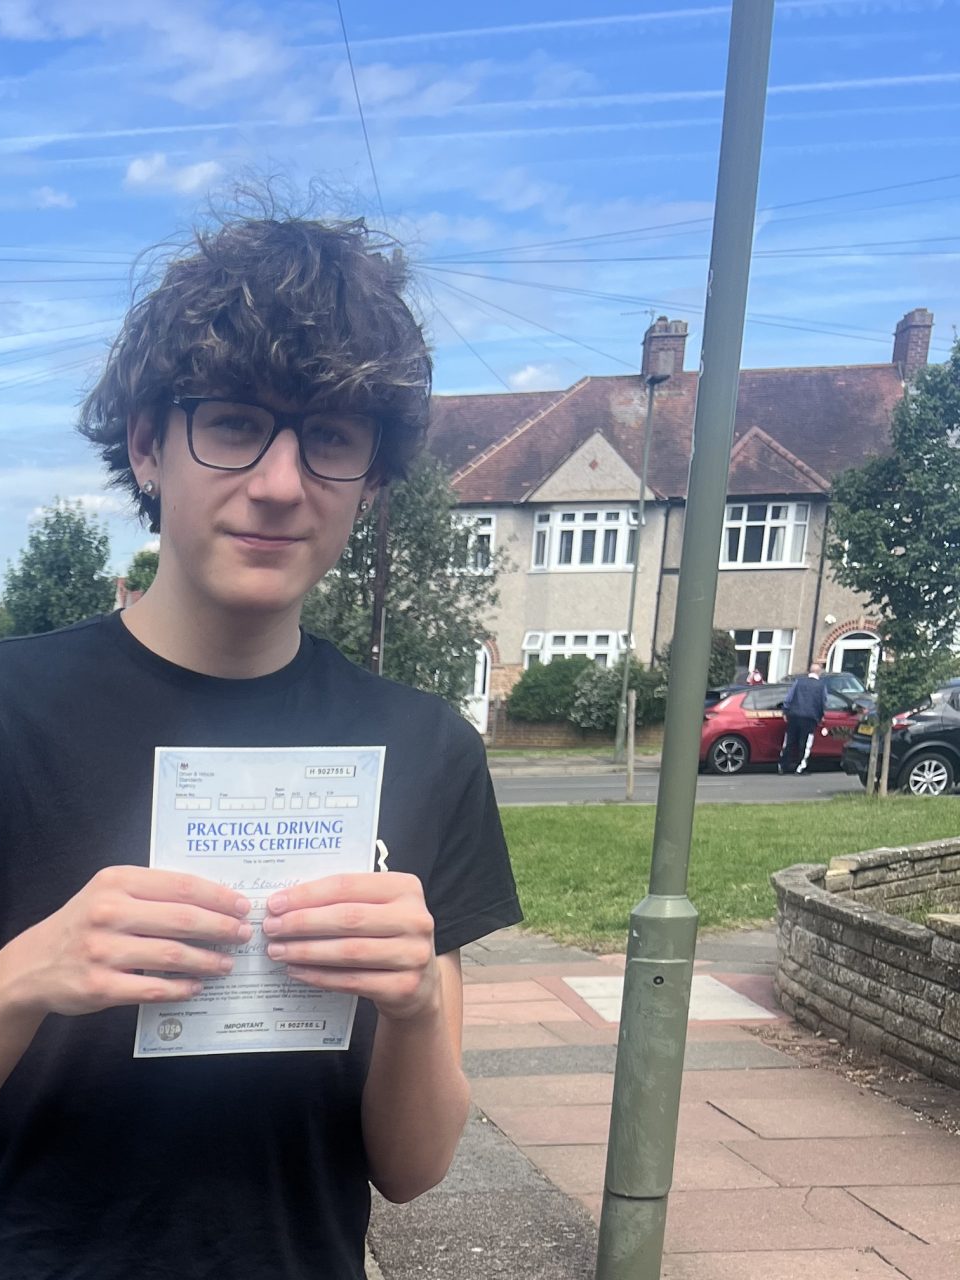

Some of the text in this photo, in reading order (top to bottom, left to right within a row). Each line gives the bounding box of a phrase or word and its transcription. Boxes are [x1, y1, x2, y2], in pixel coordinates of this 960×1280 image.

[187, 820, 343, 836] PRACTICAL DRIVING
[187, 837, 342, 852] TEST PASS CERTIFICATE
[224, 1022, 264, 1030] IMPORTANT
